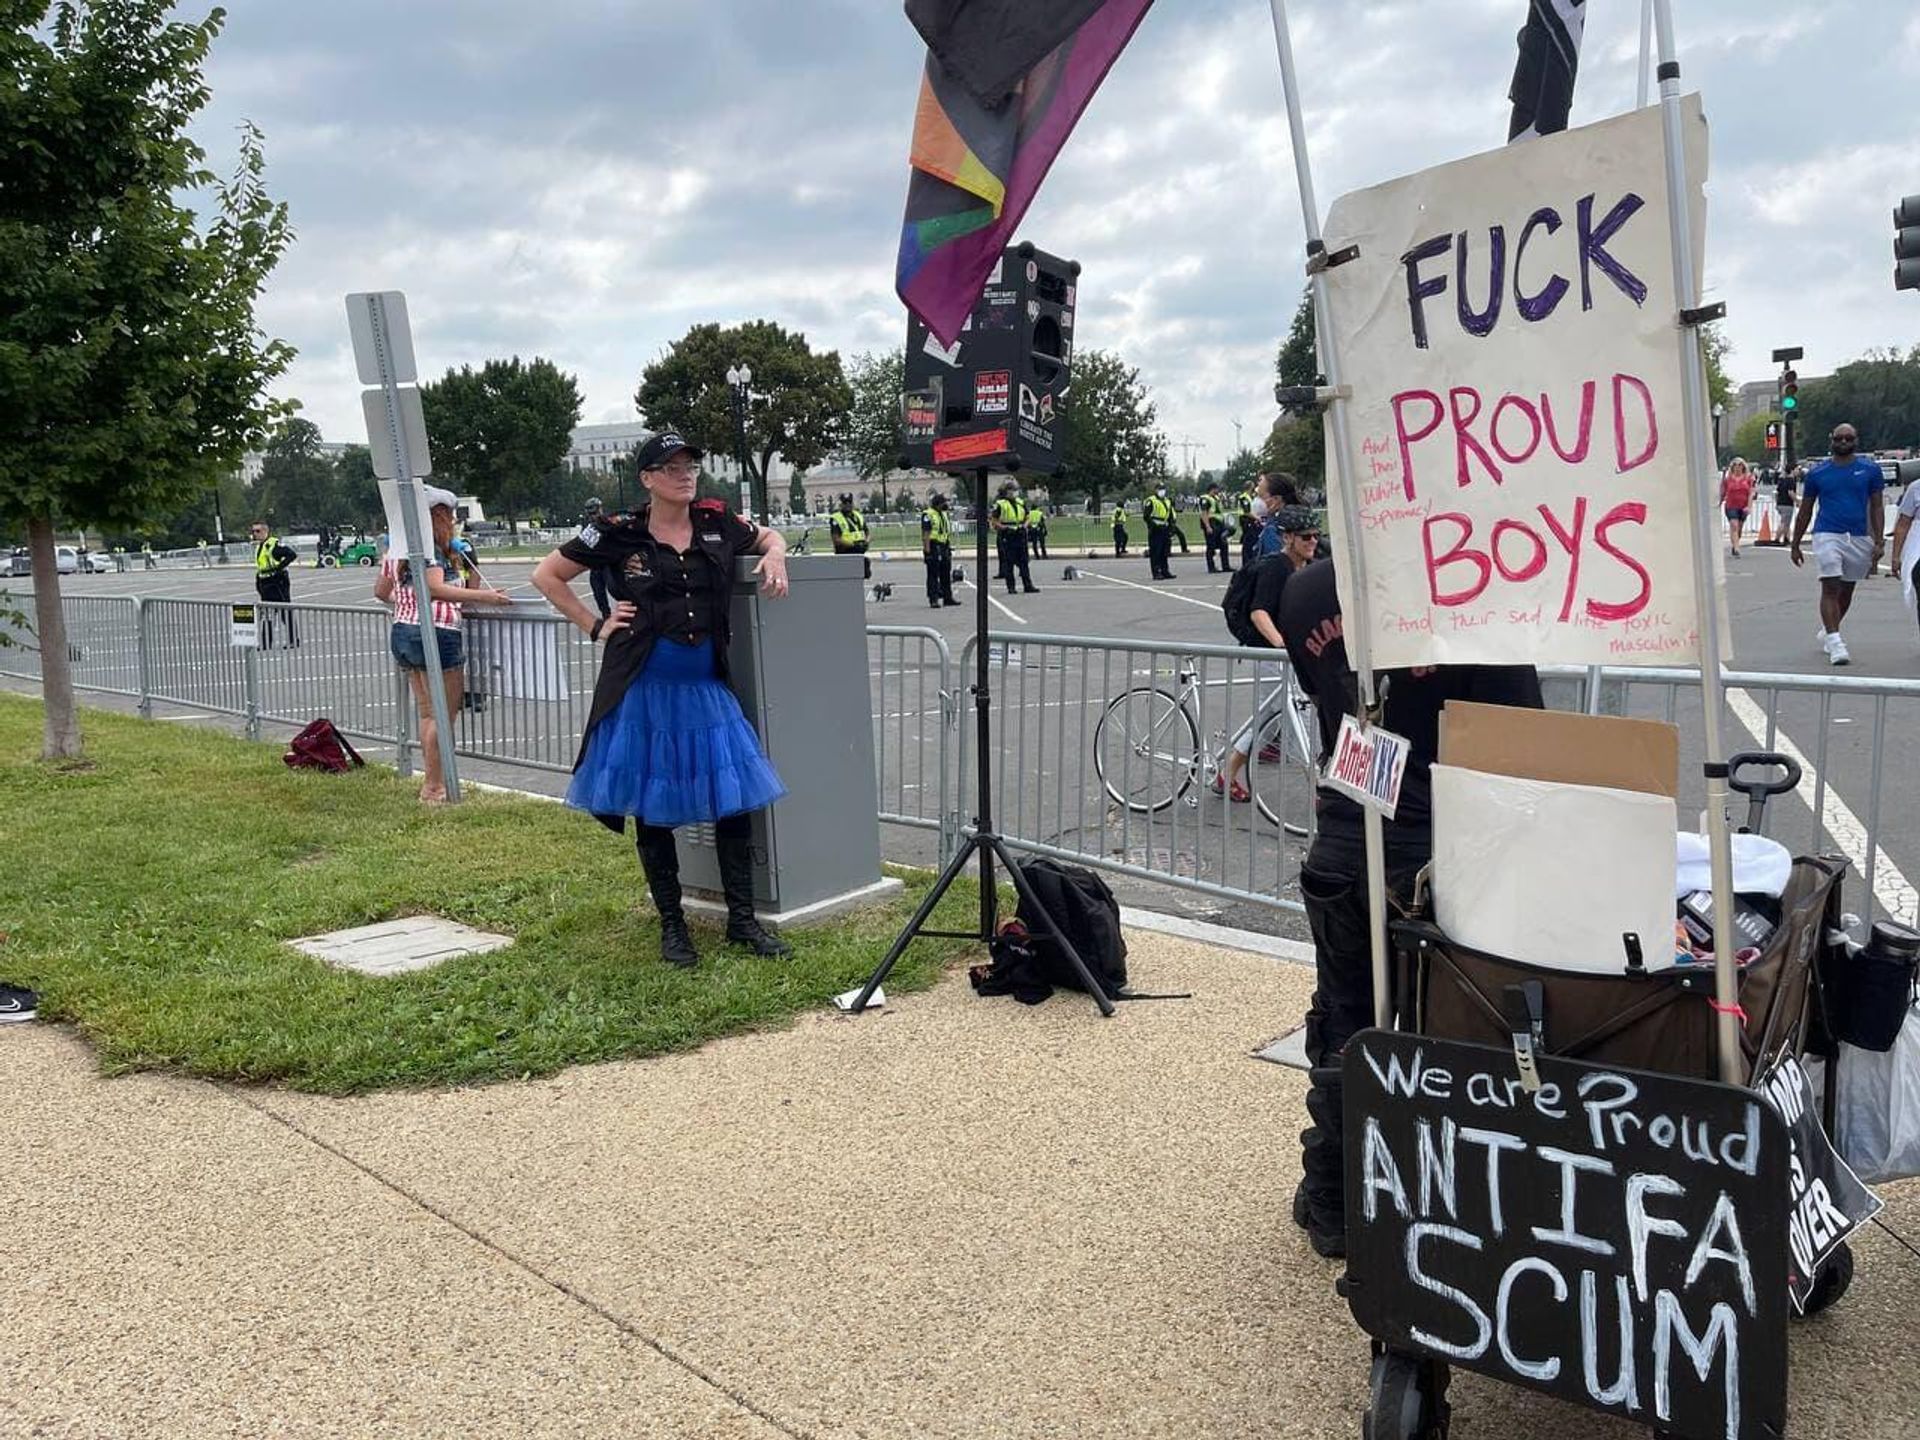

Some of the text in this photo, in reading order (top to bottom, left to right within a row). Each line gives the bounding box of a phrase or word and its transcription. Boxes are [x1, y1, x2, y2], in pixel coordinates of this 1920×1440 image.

[1400, 192, 1648, 349] FUCK
[1391, 373, 1657, 502] PROUD
[1422, 497, 1653, 622] BOYS
[1450, 612, 1496, 630] their
[1508, 604, 1543, 625] sad
[1609, 629, 1703, 654] masculinit
[1363, 1045, 1762, 1176] We are Proud
[1361, 1115, 1757, 1317] ANTIFA
[1790, 1177, 1851, 1279] OVER
[1405, 1222, 1741, 1439] SCUM
